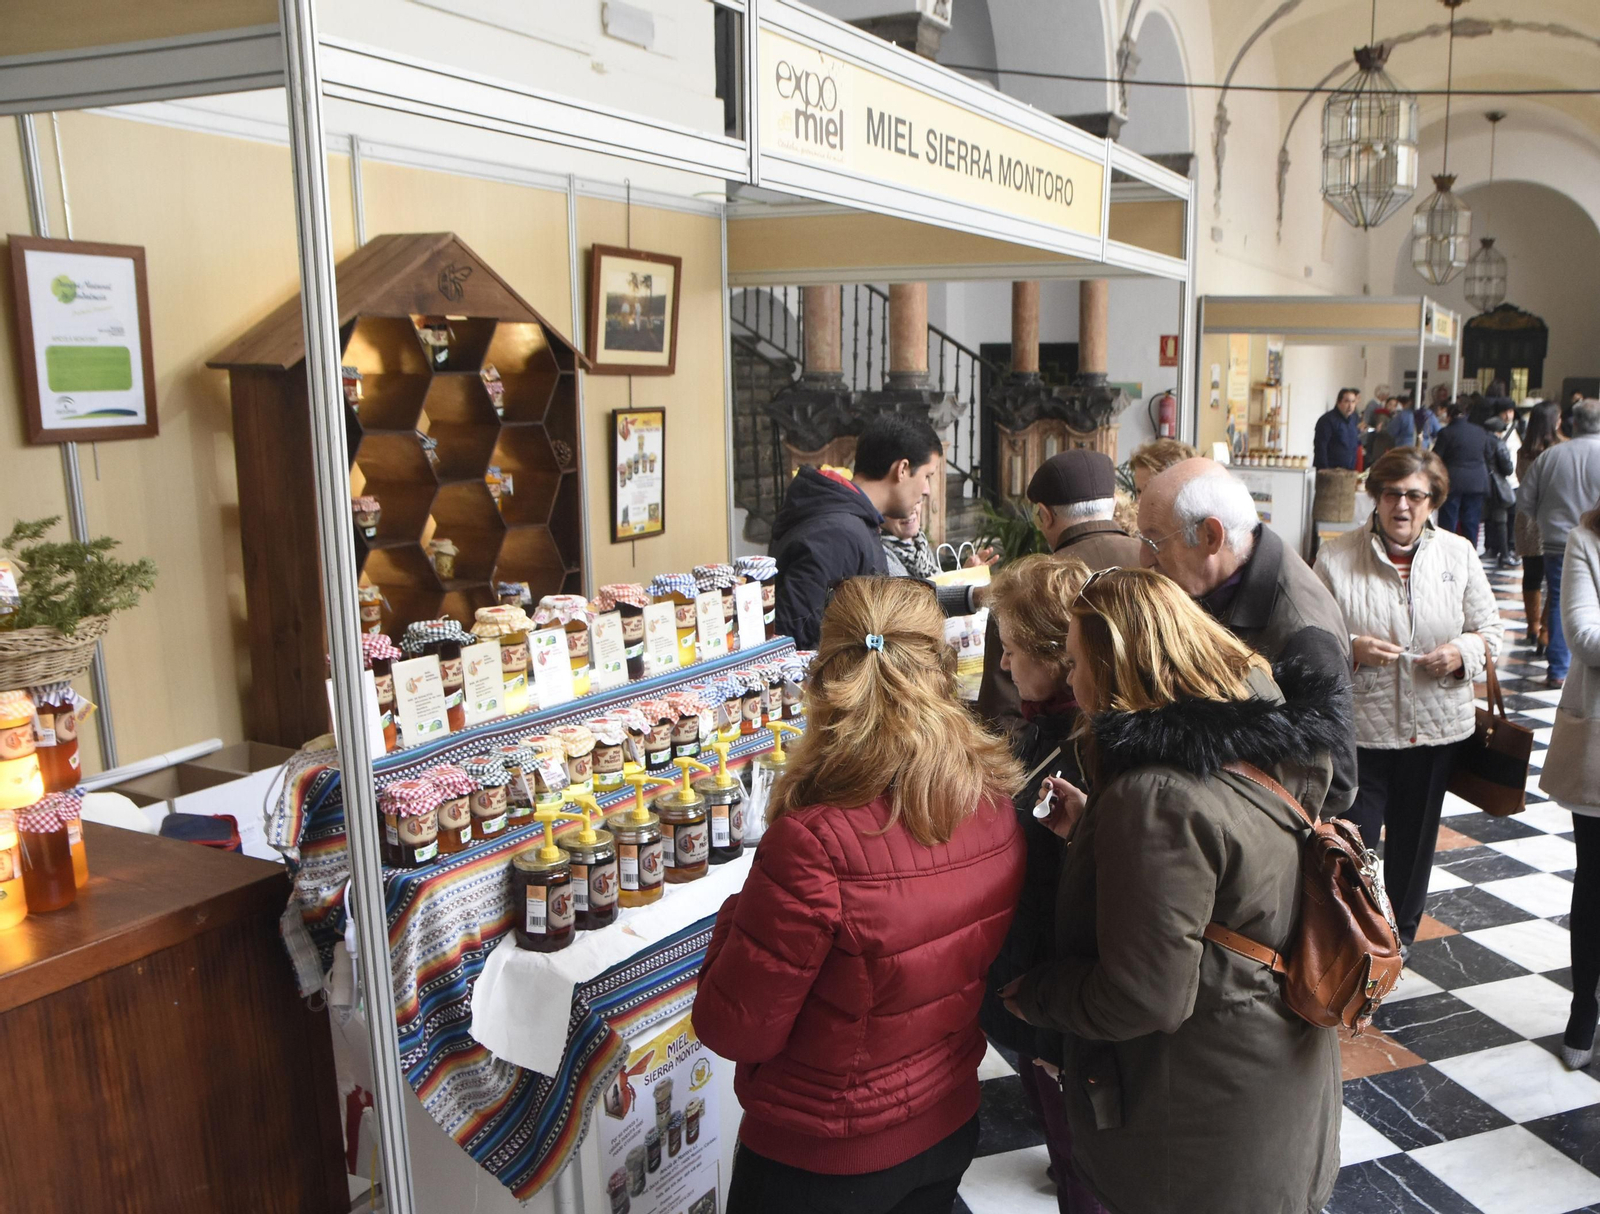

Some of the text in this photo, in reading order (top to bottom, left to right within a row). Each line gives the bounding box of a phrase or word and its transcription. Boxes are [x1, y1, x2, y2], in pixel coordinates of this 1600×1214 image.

[776, 60, 837, 112] expo
[795, 105, 843, 151] miel
[866, 107, 1074, 207] MIEL SIERRA MONTORO
[667, 1033, 689, 1058] MIEL
[644, 1060, 674, 1086] SIERRA
